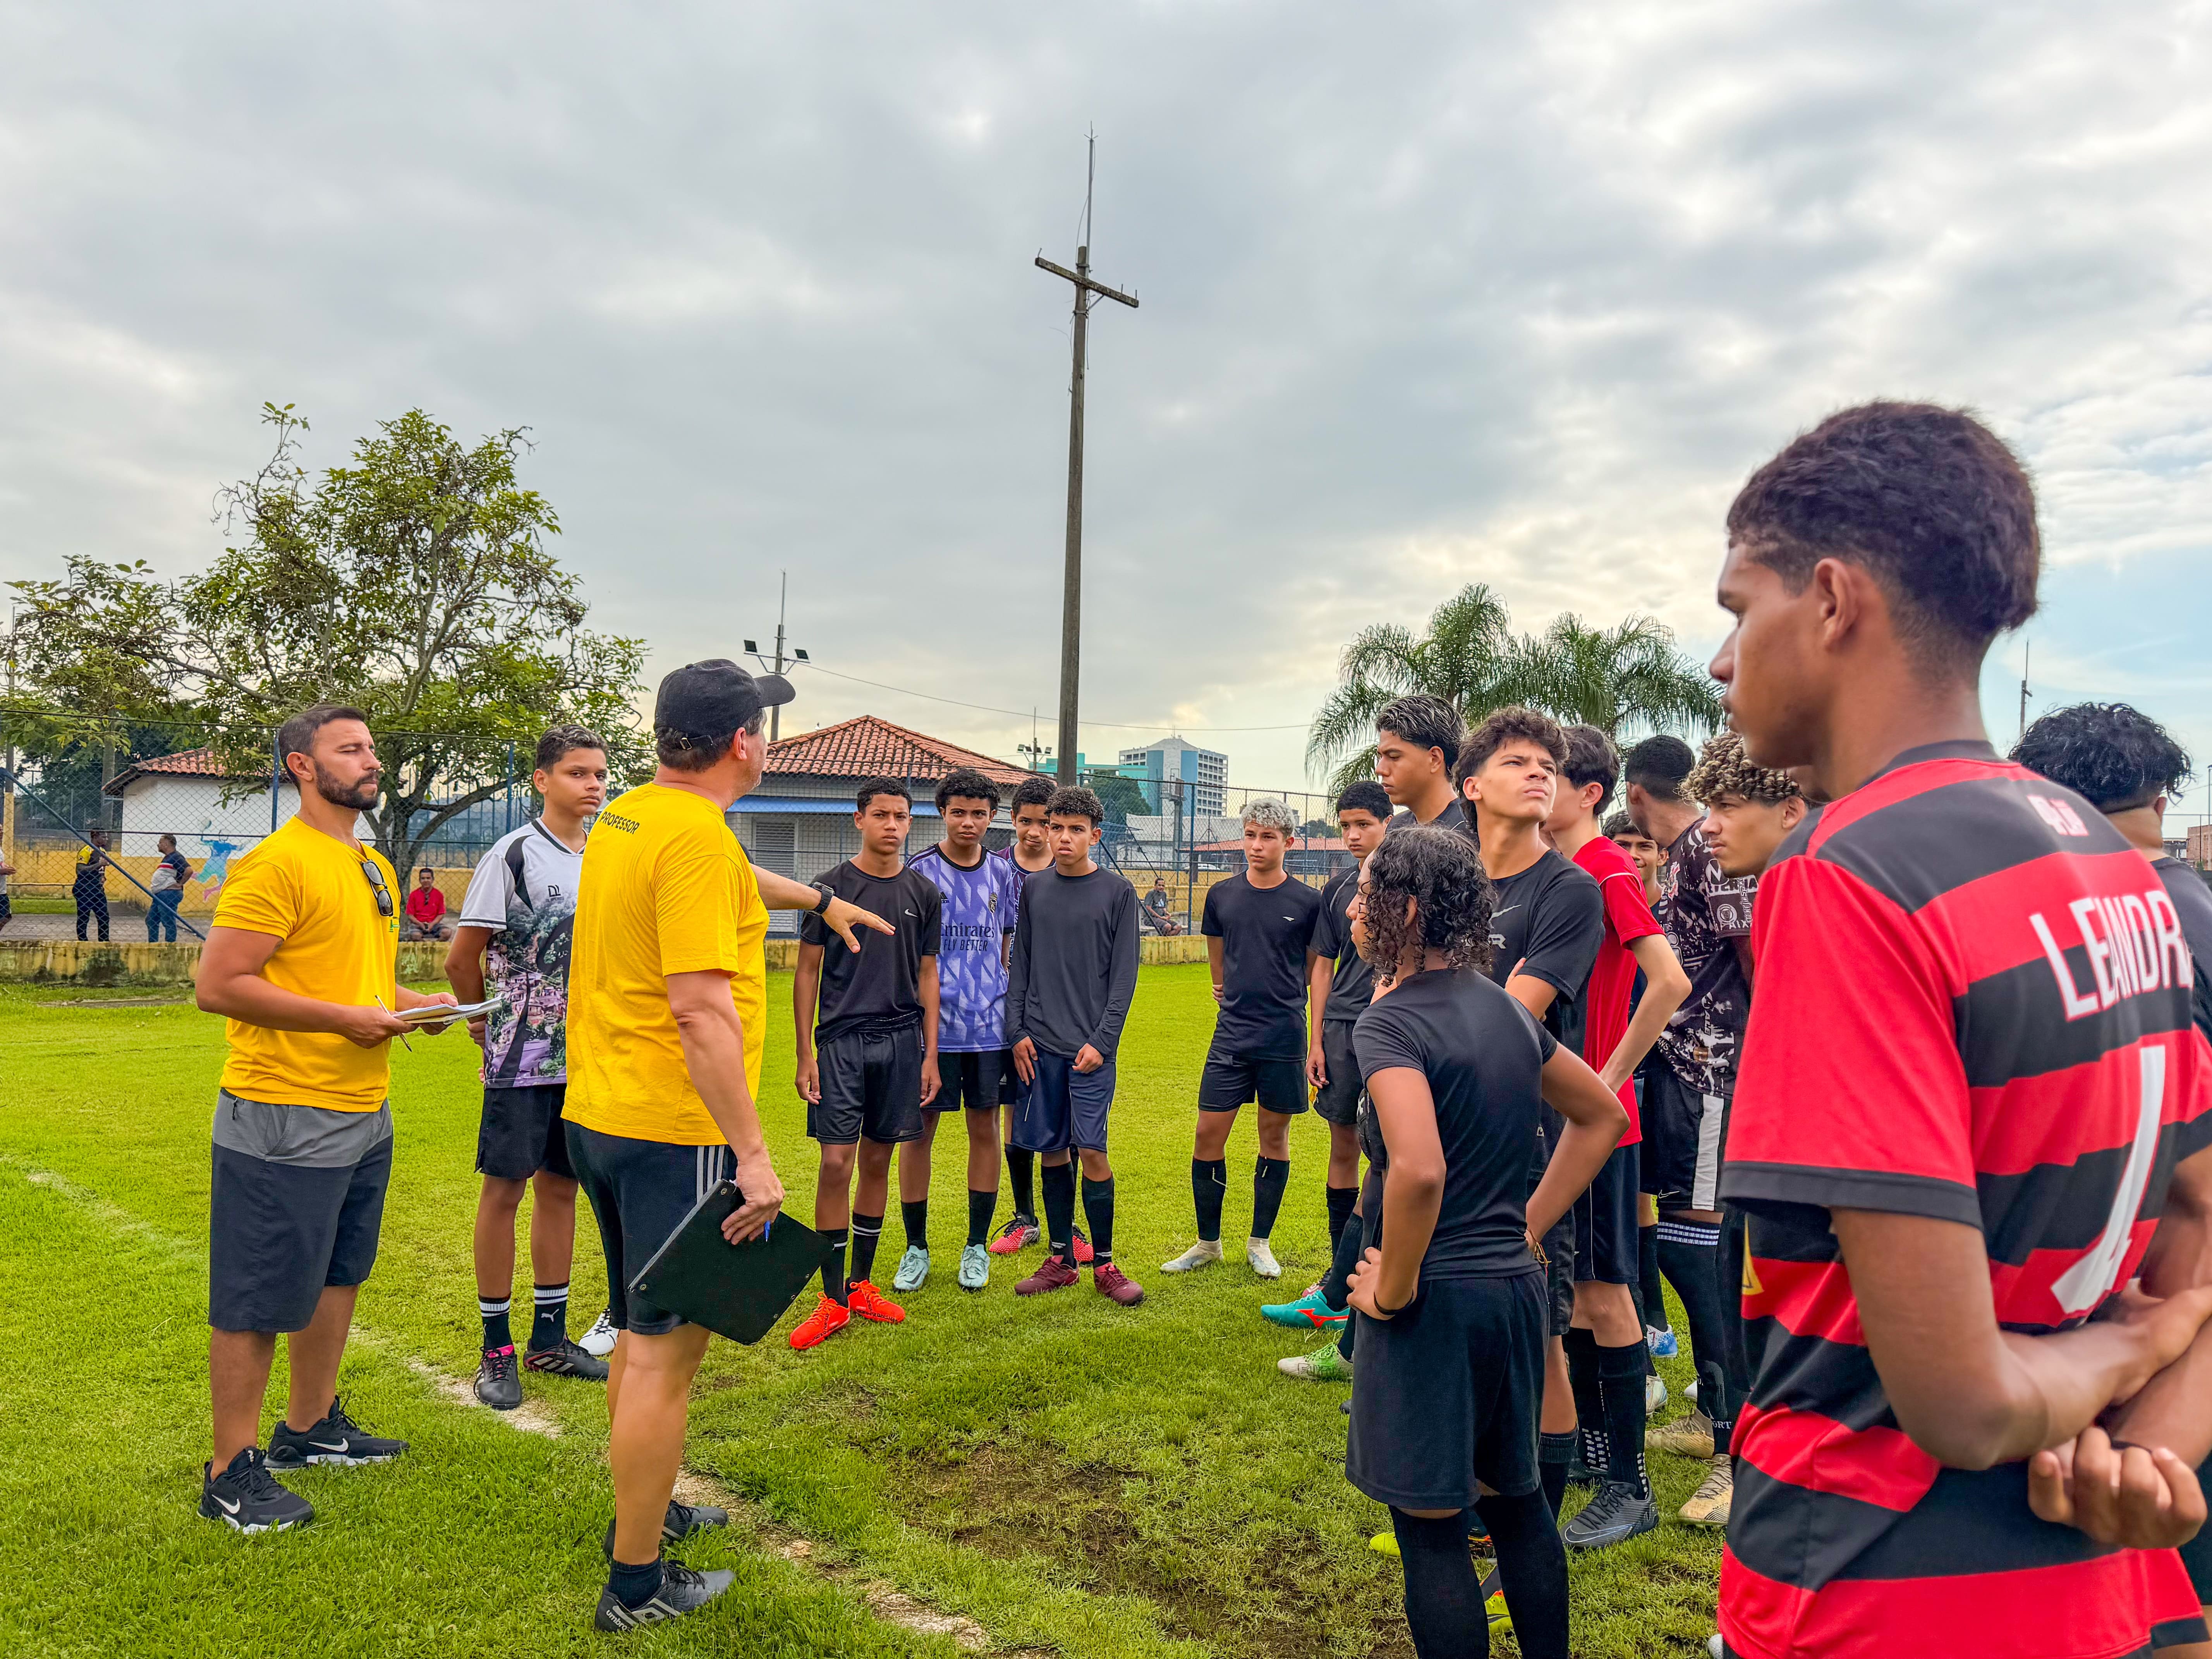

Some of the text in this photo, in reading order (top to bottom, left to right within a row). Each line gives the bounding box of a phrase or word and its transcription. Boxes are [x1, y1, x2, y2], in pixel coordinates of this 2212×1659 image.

[599, 811, 640, 835] PROFESSOR
[943, 939, 988, 951] FLY BETTER
[2028, 890, 2194, 1023] LEANDR
[606, 1609, 627, 1630] umbro
